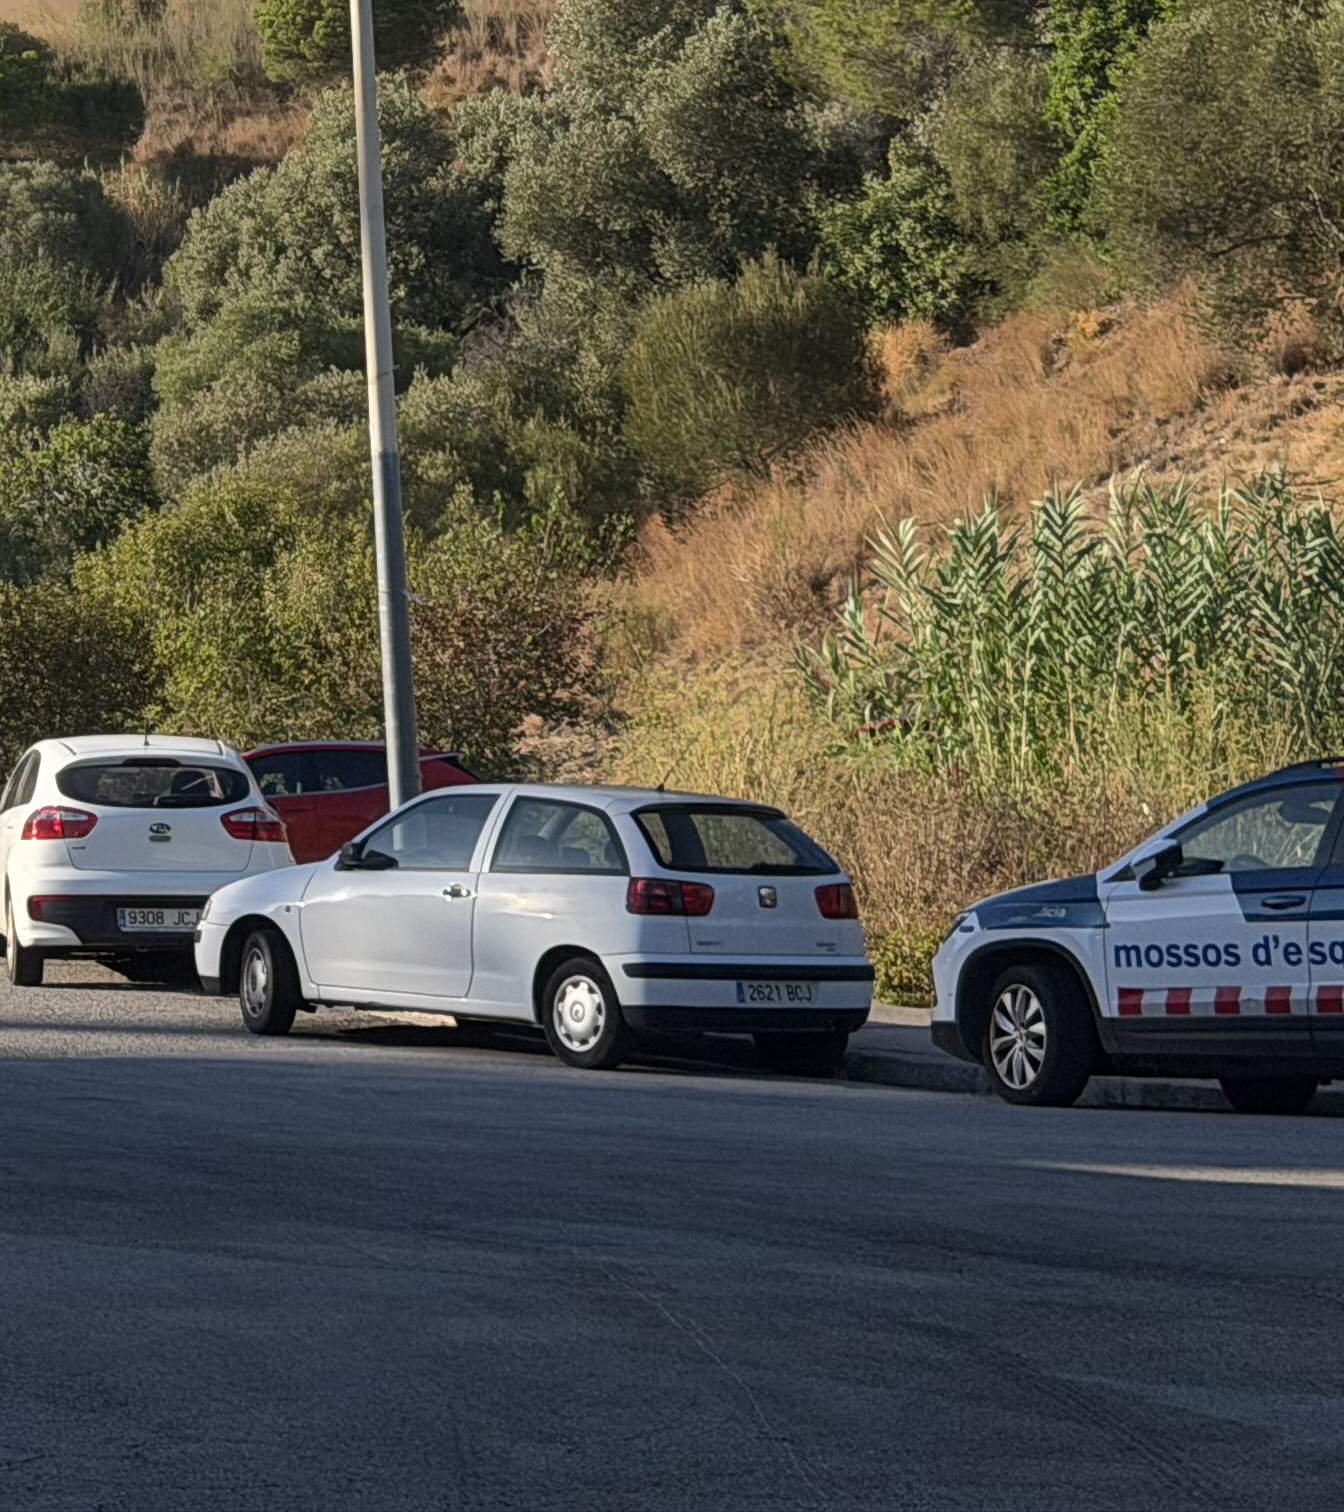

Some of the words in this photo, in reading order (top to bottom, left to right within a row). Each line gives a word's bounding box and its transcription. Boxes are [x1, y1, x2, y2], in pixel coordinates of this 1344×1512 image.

[127, 910, 165, 926] 9308
[1113, 942, 1242, 969] mossos
[747, 984, 782, 1002] 2621
[786, 984, 813, 1003] BCJ
